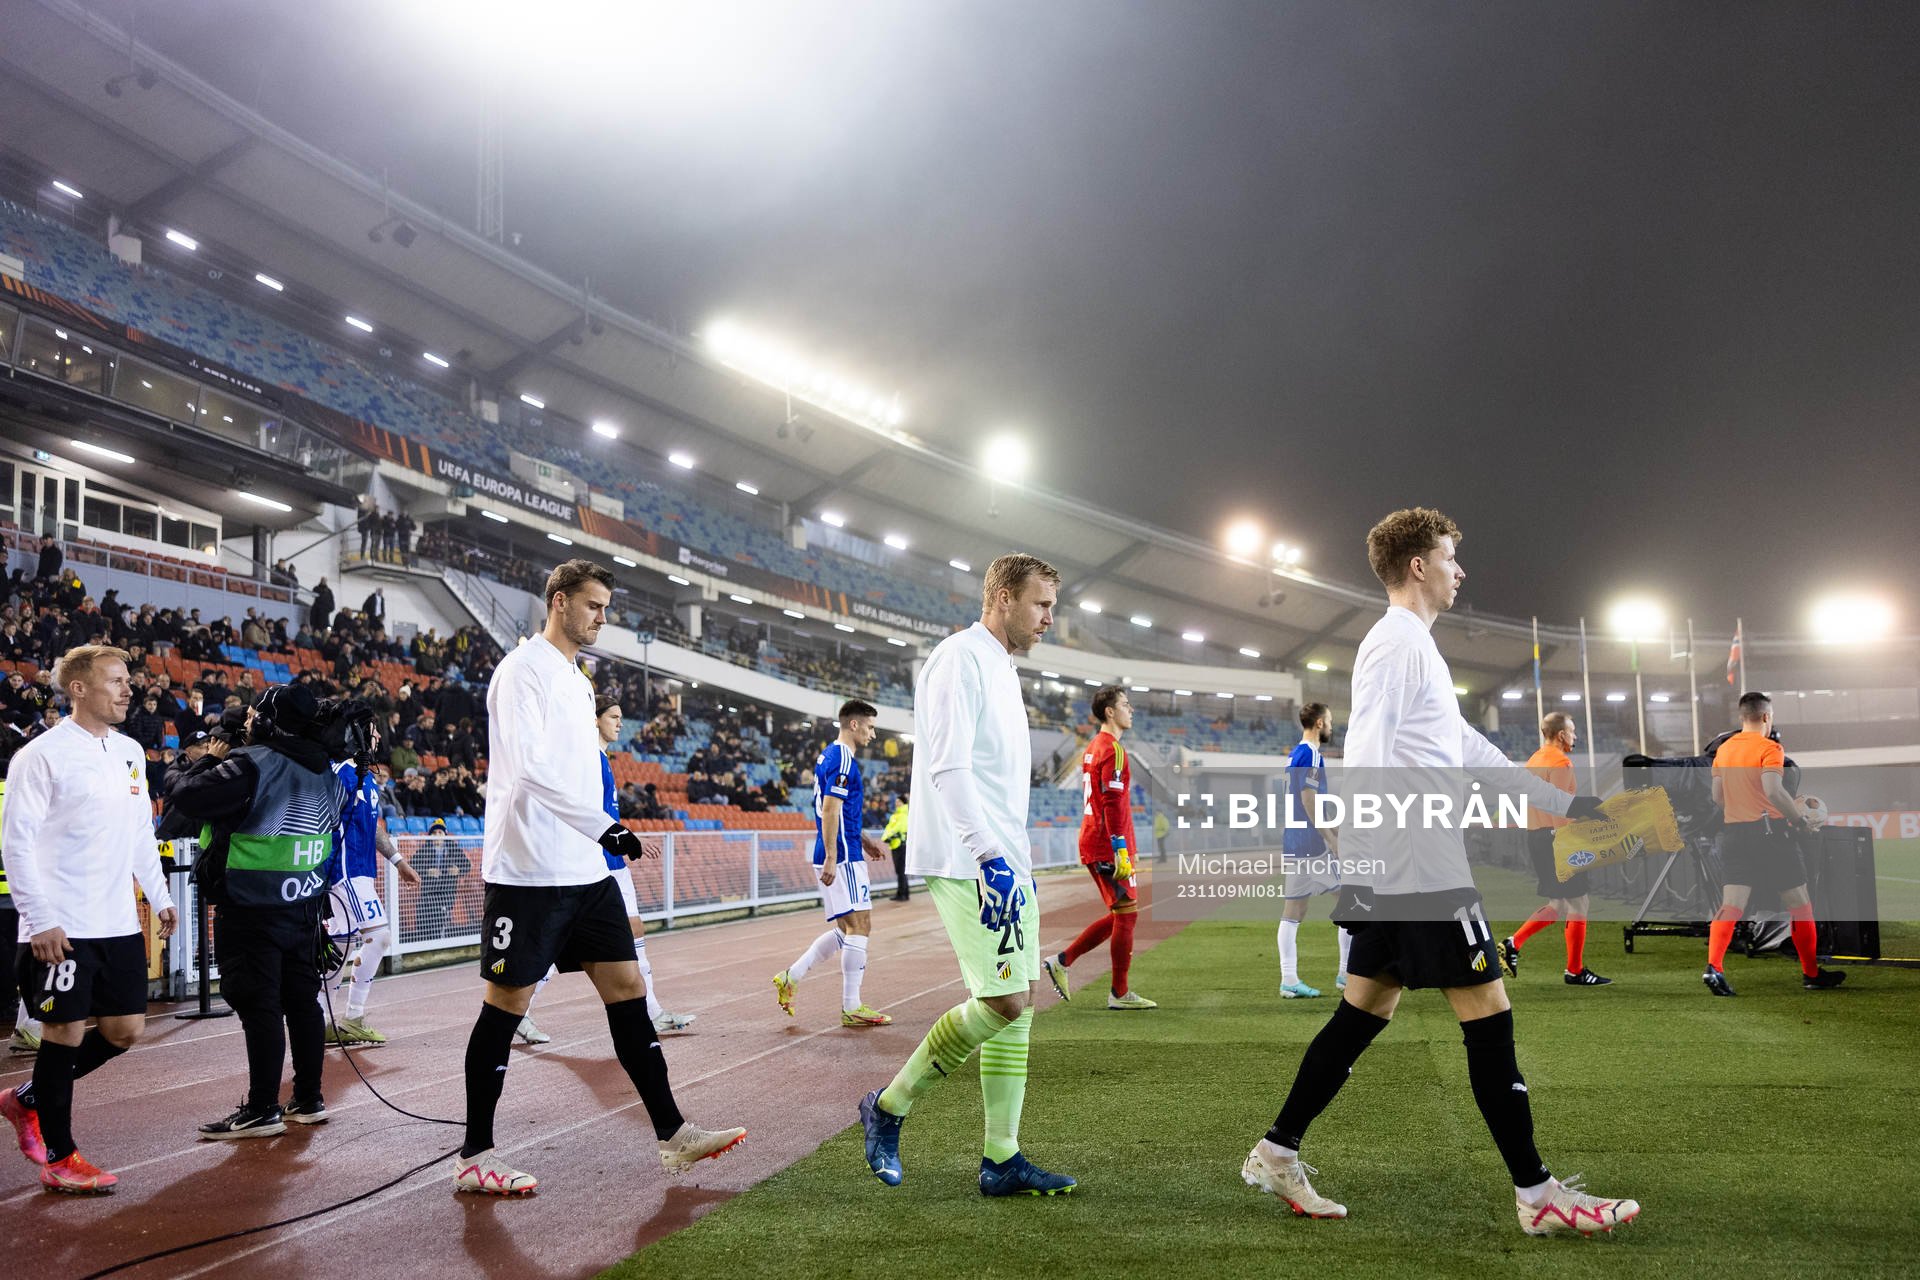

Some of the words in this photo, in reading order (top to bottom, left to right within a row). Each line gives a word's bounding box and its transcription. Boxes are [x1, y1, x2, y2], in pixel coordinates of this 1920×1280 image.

[438, 459, 470, 484] UEFA
[473, 473, 523, 503] EUROPA
[524, 492, 571, 520] LEAGUE
[853, 602, 878, 619] UEFA
[878, 609, 914, 629] EUROPA
[294, 840, 325, 865] HB
[1600, 849, 1616, 859] VS
[364, 900, 382, 920] 31
[1453, 901, 1490, 946] 11
[493, 916, 513, 950] 3
[998, 917, 1024, 956] 26
[44, 959, 77, 992] 18
